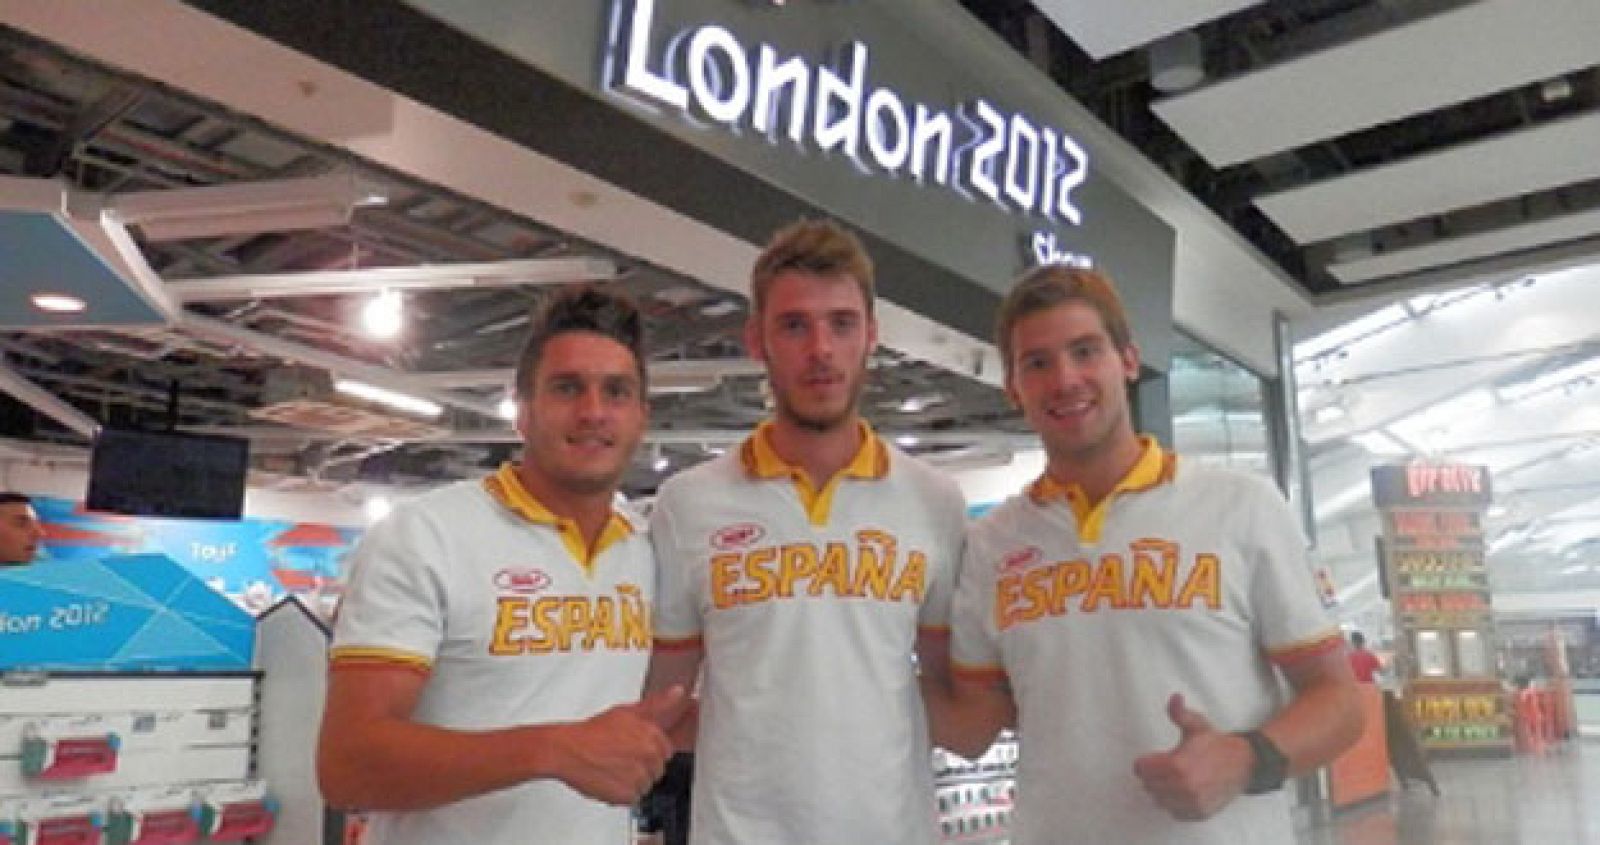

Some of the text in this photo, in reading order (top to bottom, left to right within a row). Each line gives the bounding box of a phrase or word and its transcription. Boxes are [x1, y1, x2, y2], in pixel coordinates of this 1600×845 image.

[622, 0, 1088, 225] London 2012
[711, 528, 926, 610] ESPAÑA
[994, 537, 1221, 631] ESPAÑA
